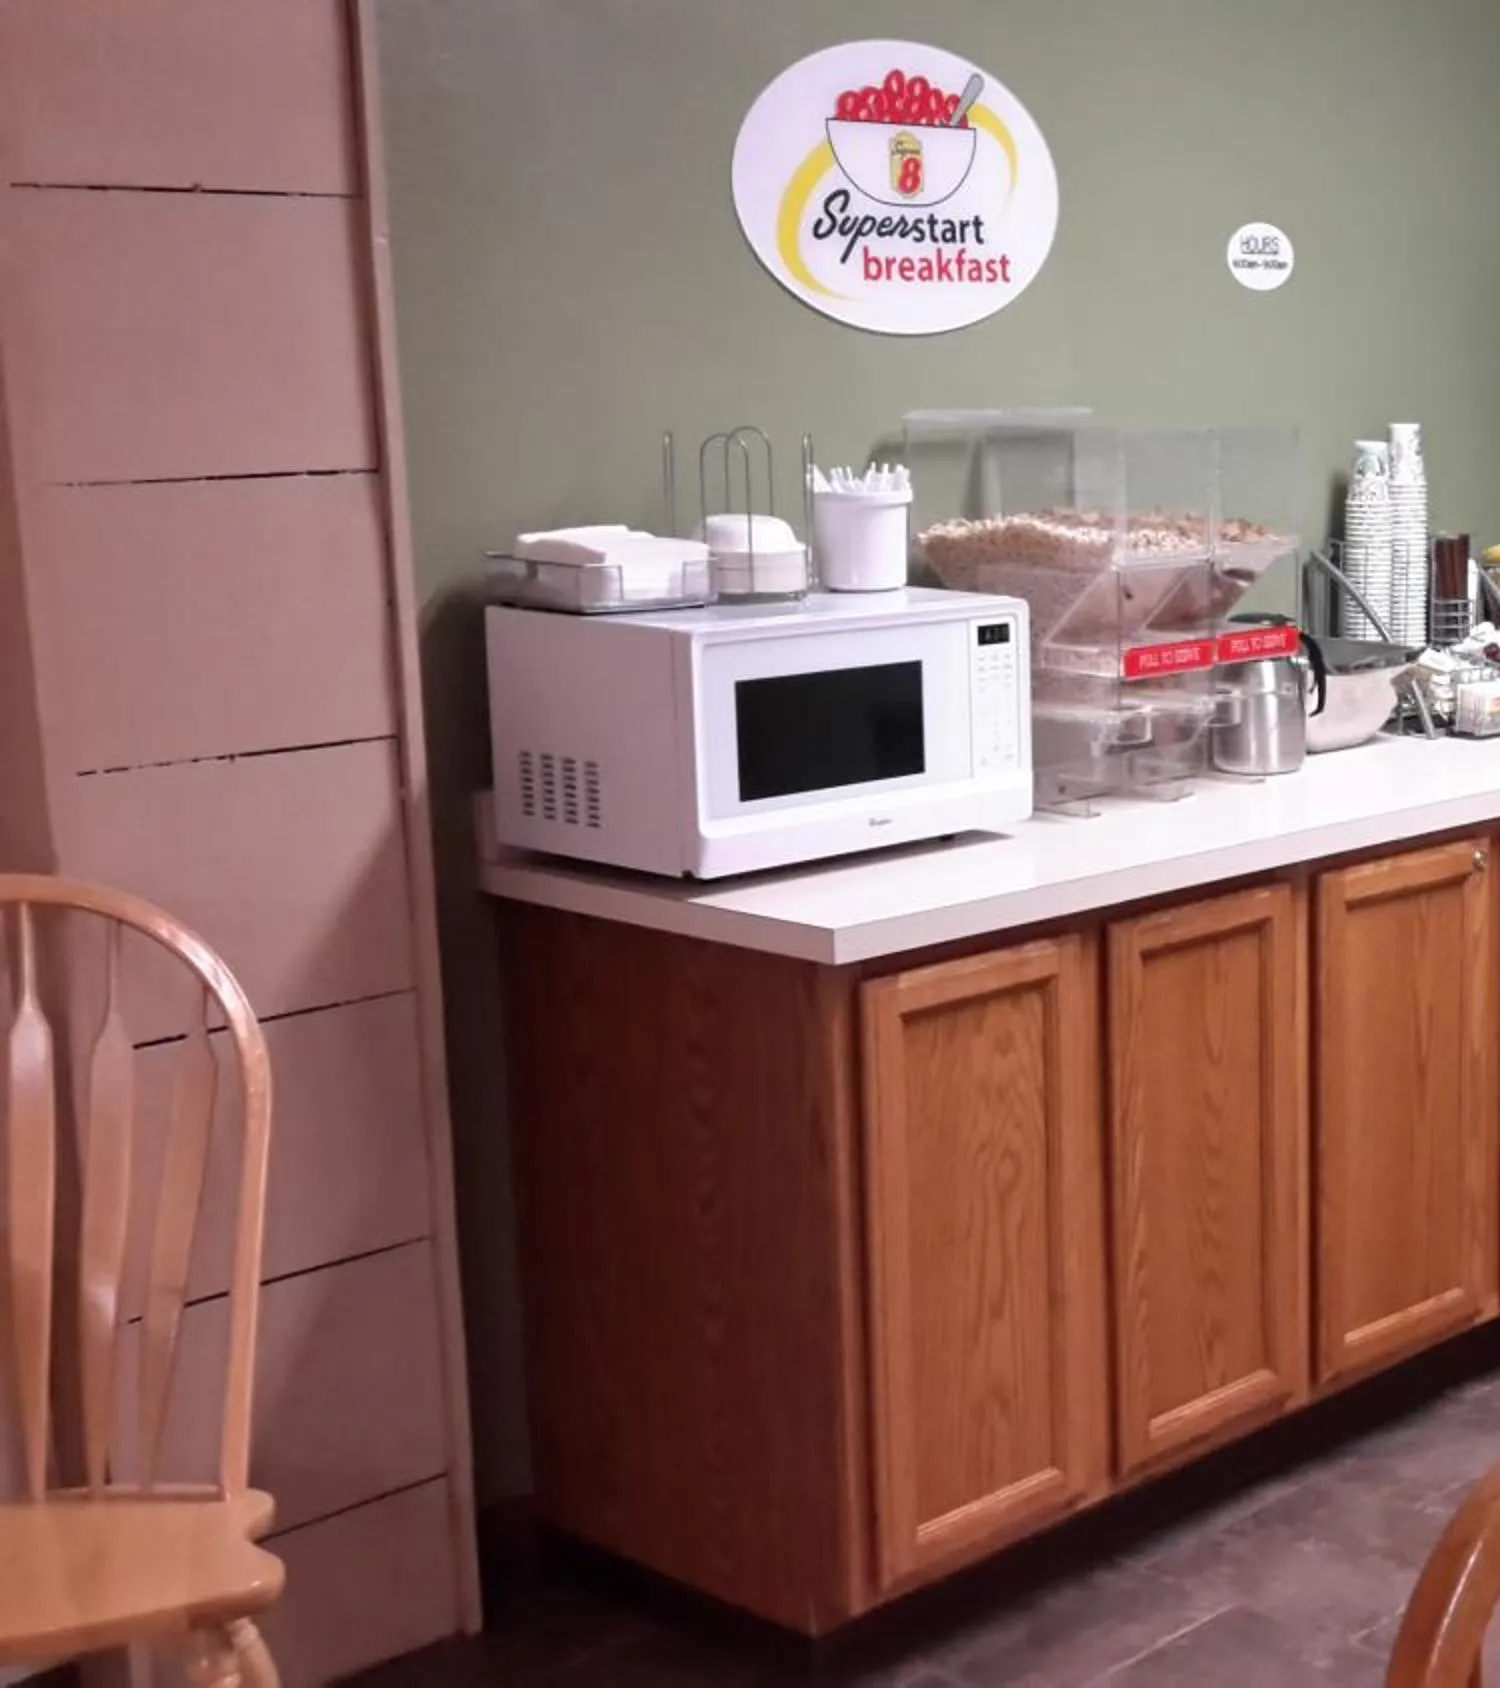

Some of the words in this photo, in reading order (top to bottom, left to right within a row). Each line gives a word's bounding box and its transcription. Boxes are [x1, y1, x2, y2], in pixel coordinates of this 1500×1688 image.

[898, 158, 922, 194] 8
[812, 187, 985, 264] Superstart
[1240, 234, 1280, 251] HOURS
[863, 245, 1012, 283] breakfast
